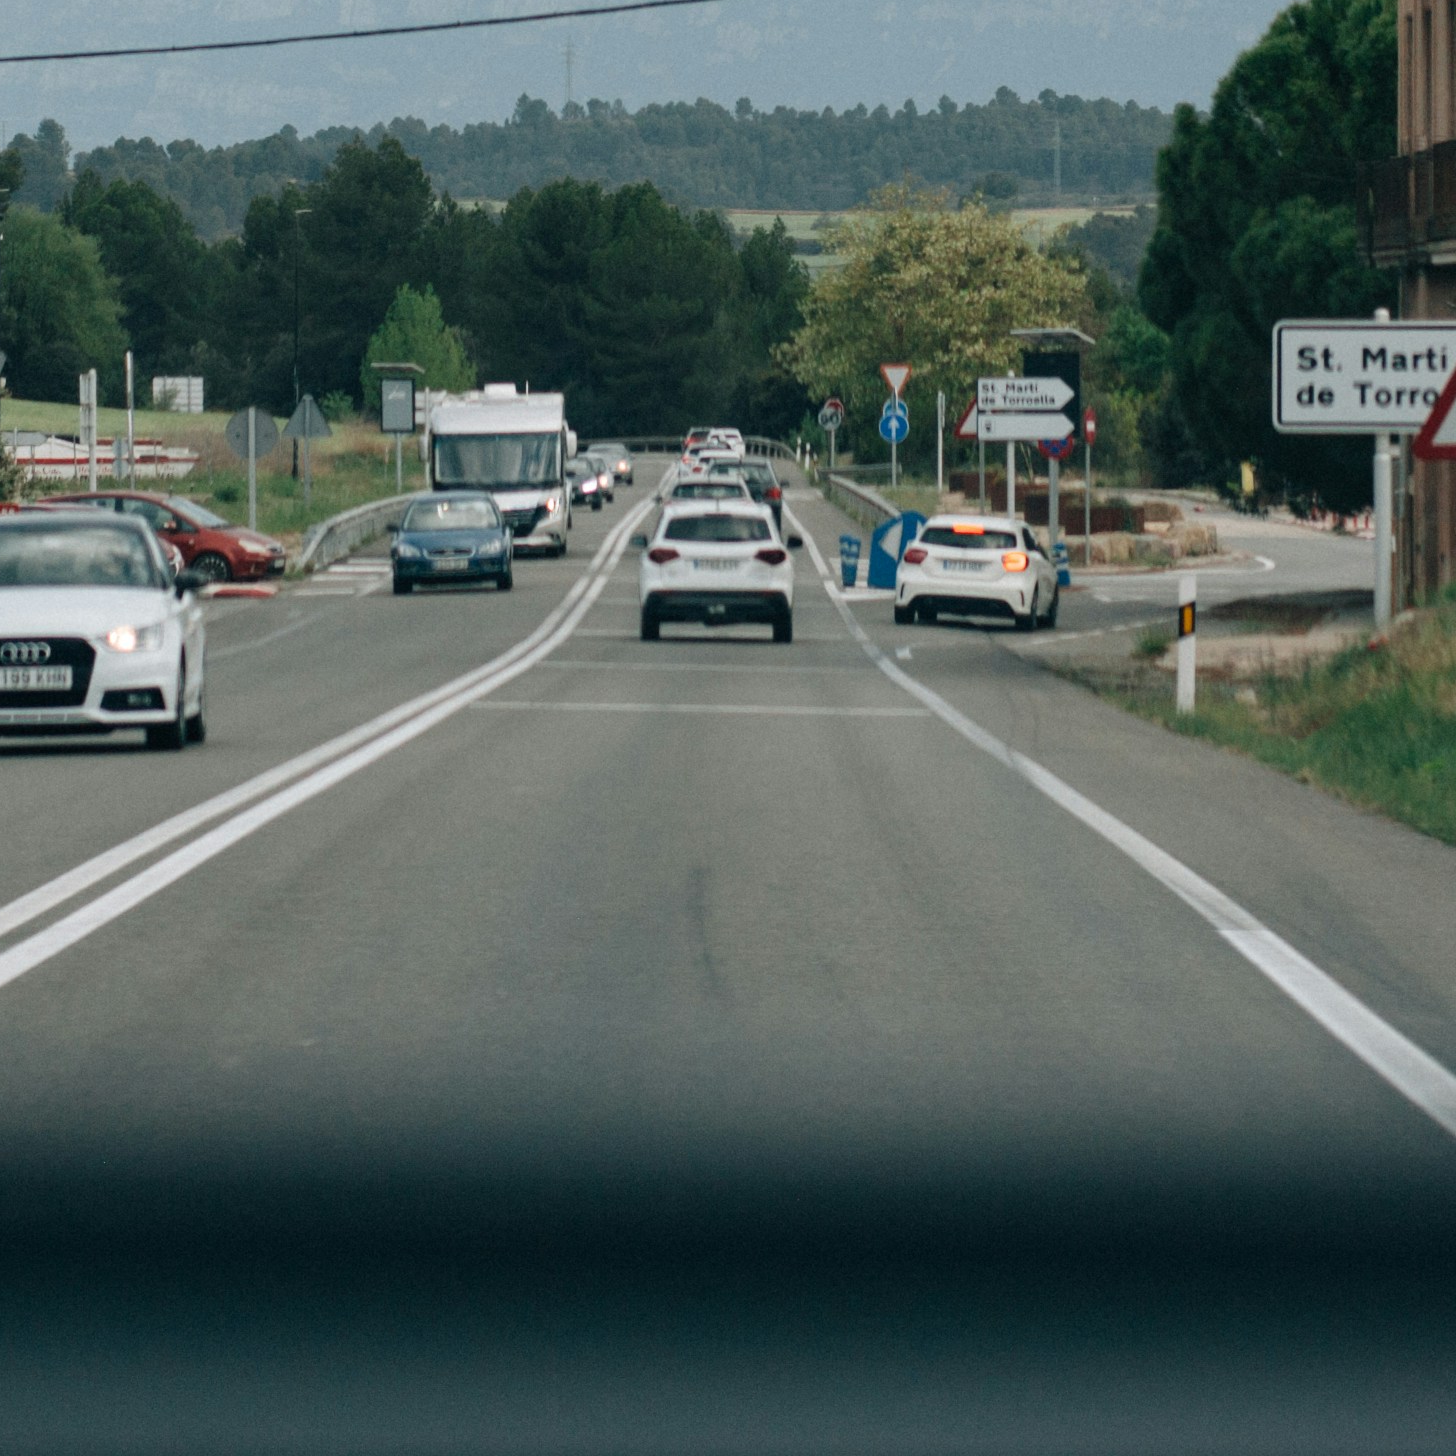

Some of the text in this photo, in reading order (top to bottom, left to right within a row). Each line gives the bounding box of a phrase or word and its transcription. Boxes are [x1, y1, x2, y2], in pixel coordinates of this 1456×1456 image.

[1296, 345, 1342, 373] St.
[981, 395, 996, 405] de
[1296, 380, 1439, 409] de Torro
